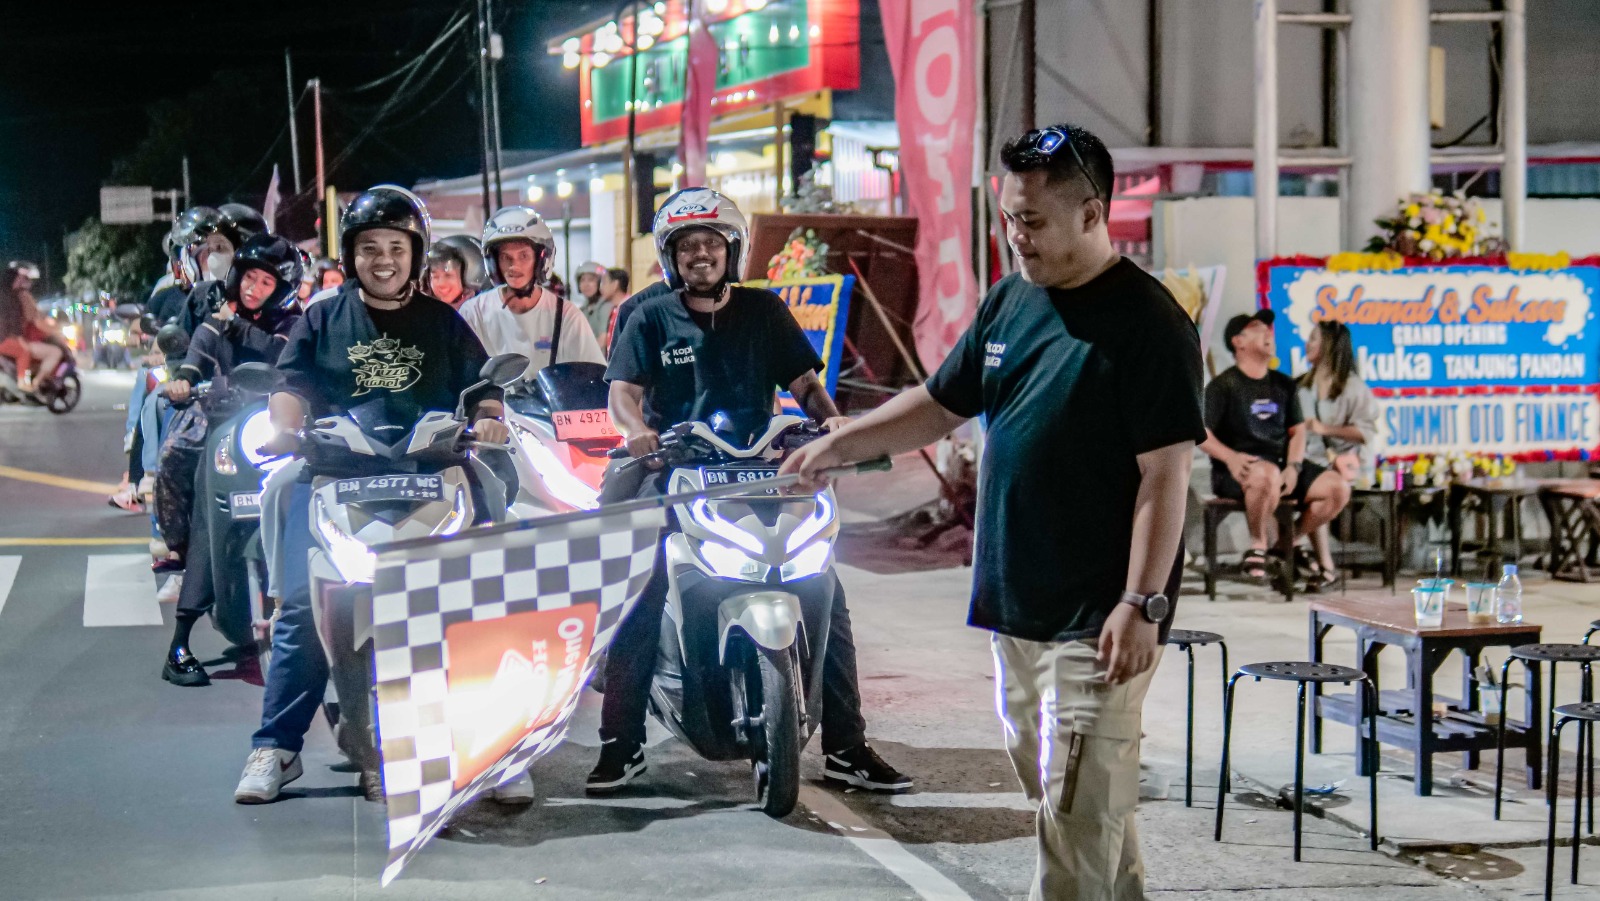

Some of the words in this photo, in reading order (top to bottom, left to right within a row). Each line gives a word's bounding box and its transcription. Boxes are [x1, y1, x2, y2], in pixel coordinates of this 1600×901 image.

[1311, 285, 1435, 324] Selamat
[1438, 289, 1461, 324] &
[1392, 324, 1442, 346] GRAND
[1444, 324, 1507, 345] OPENING
[672, 345, 693, 356] kopi
[674, 355, 695, 365] kuka
[1357, 345, 1433, 381] kuka
[1443, 354, 1518, 380] TANJUNG
[1520, 353, 1586, 379] PANDAN
[556, 414, 572, 425] BN
[580, 411, 607, 423] 4927
[1386, 404, 1459, 447] SUMMIT
[1469, 403, 1504, 443] OTO
[1515, 401, 1590, 442] FINANCE
[339, 480, 360, 492] BN
[366, 477, 409, 488] 4977
[416, 477, 439, 487] WC
[707, 471, 728, 483] BN
